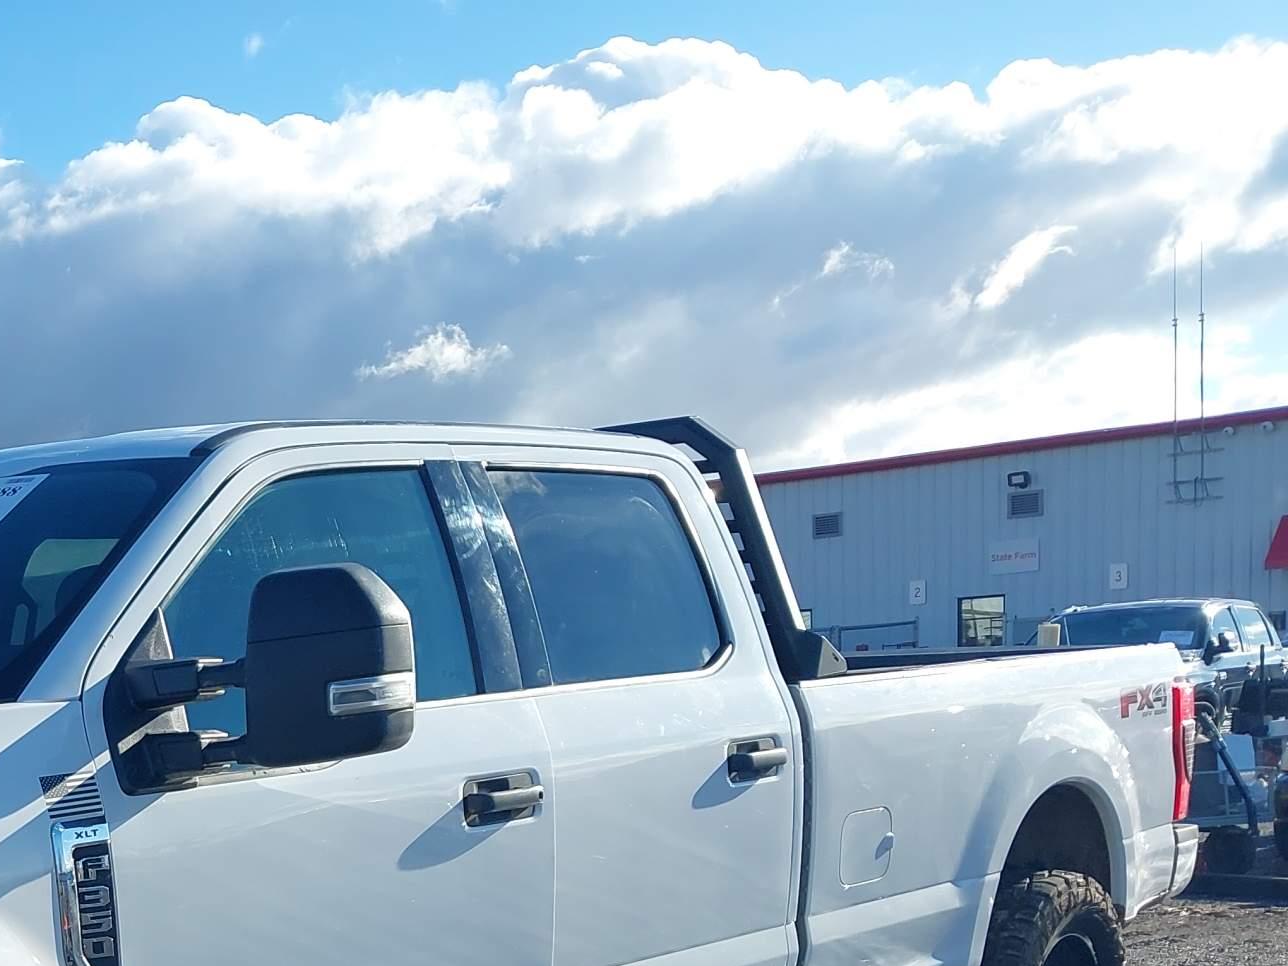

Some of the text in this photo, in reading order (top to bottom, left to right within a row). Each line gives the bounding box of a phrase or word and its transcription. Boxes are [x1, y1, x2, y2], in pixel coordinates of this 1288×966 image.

[991, 551, 1037, 562] State Farm
[1114, 570, 1123, 582] 3
[914, 587, 922, 598] 2
[1120, 682, 1168, 718] FX4
[74, 828, 99, 840] XLT
